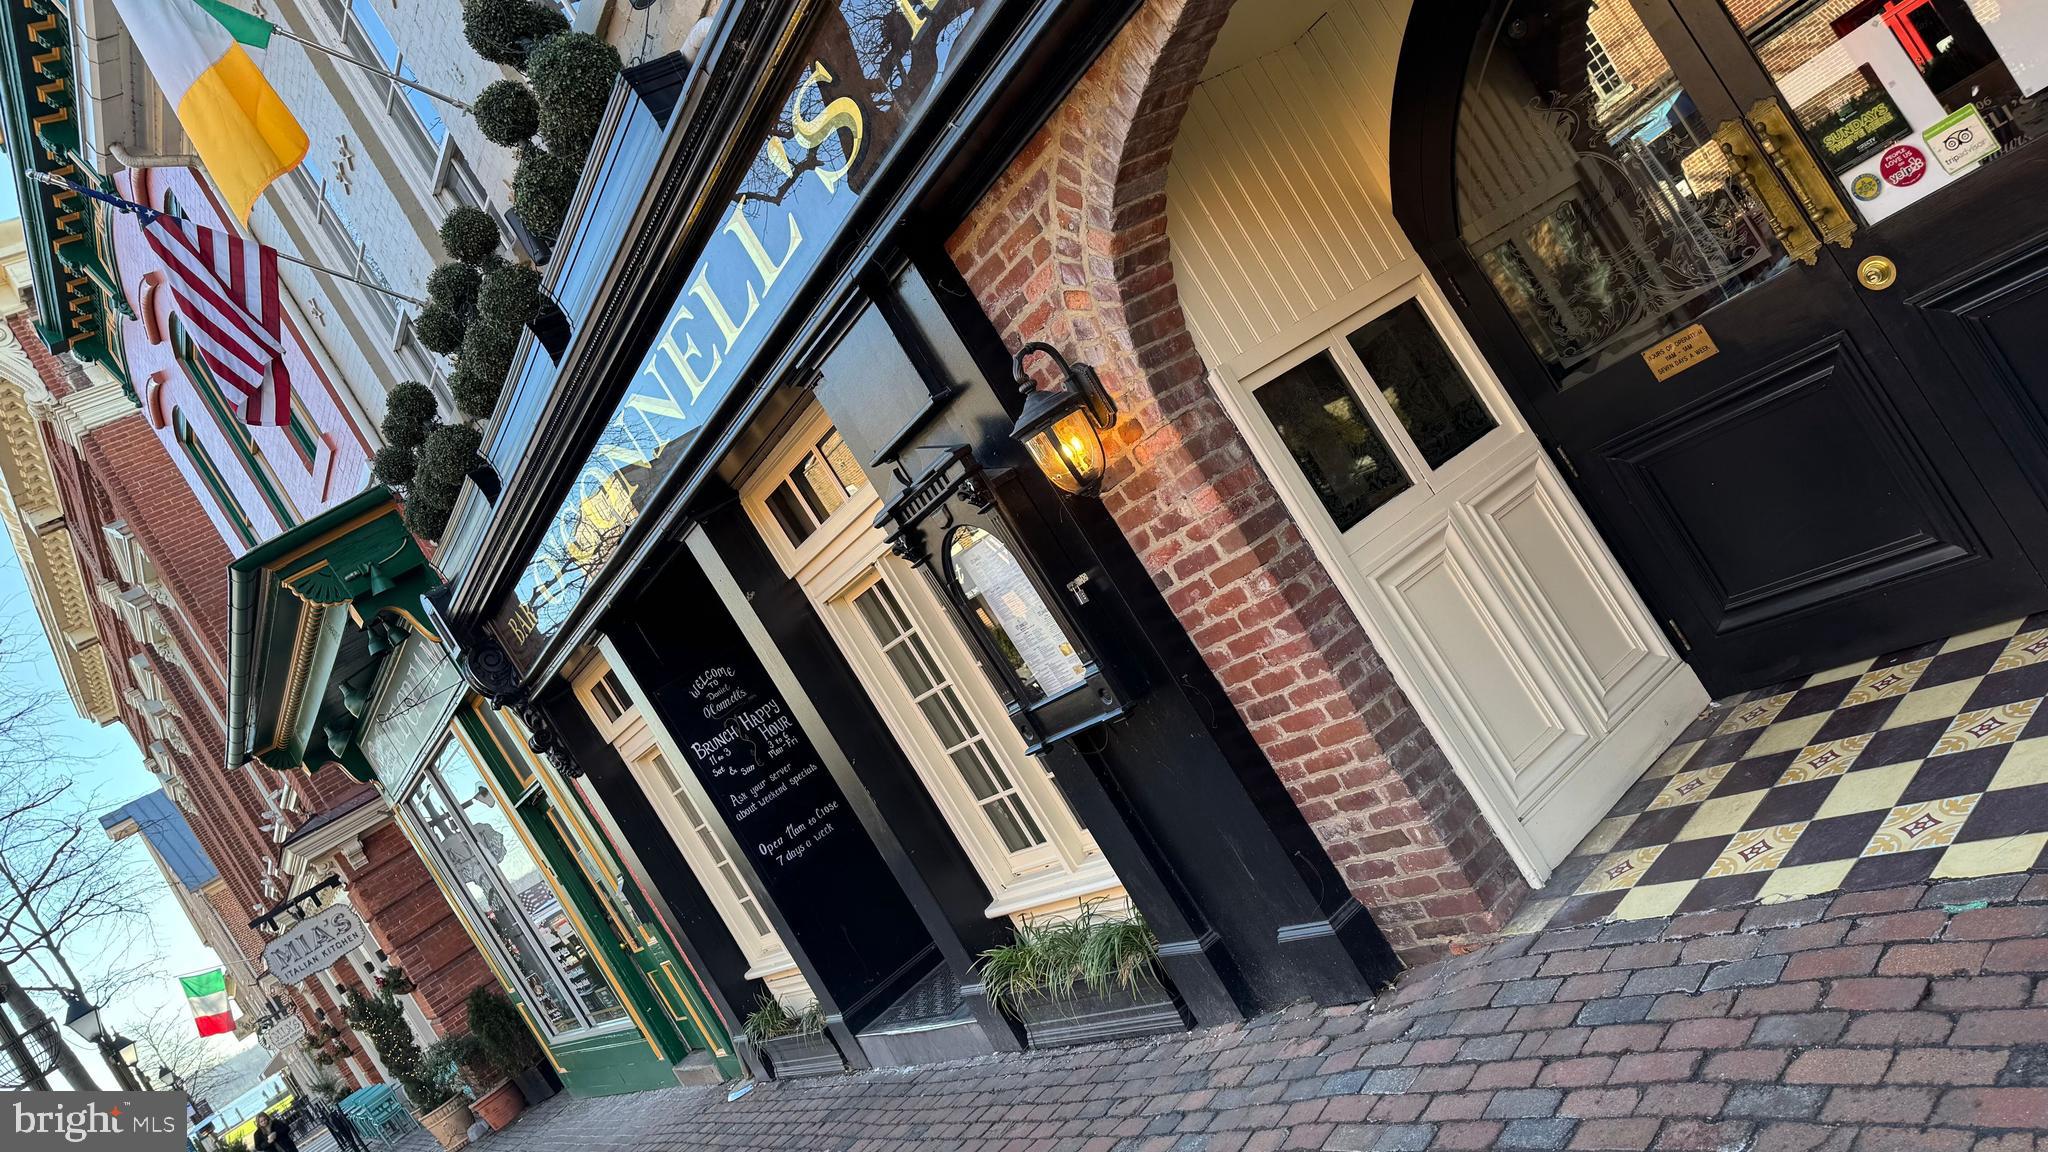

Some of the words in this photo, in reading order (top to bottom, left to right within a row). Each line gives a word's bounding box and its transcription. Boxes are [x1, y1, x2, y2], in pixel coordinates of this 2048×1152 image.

[1823, 102, 1889, 147] SUNDAYS
[1829, 128, 1866, 154] THRIVE
[1864, 112, 1894, 134] HERE
[1885, 147, 1906, 161] PEOPLE
[1885, 156, 1903, 168] LOVE
[1902, 150, 1912, 159] US
[1945, 140, 1986, 165] tripadvisor
[1889, 165, 1913, 184] yelp
[532, 60, 863, 606] O'CONNELL'S
[1665, 344, 1673, 352] OF
[1658, 363, 1674, 375] SEVEN
[1675, 356, 1689, 366] DAYS
[1695, 345, 1711, 355] WEEK
[508, 603, 537, 646] BAR
[689, 666, 735, 699] WELCOME
[706, 684, 731, 701] Daniel
[707, 679, 719, 688] TO
[703, 689, 747, 719] O'Connell's
[691, 725, 739, 760] BRUNCH
[758, 715, 793, 741] HOUR
[767, 740, 775, 749] 3
[775, 736, 783, 745] to
[782, 731, 789, 740] 6
[723, 748, 732, 759] 3
[768, 736, 799, 759] Mon-Fri
[712, 766, 726, 777] Sat
[729, 766, 738, 775] &
[740, 764, 756, 776] Sun
[729, 792, 748, 807] Ask
[750, 777, 766, 797] your
[769, 762, 792, 782] server
[735, 802, 758, 821] about
[758, 782, 788, 807] weekend
[789, 763, 818, 787] specials
[758, 838, 784, 856] Open
[808, 816, 817, 827] to
[815, 800, 839, 819] Close
[776, 855, 784, 866] 7
[785, 843, 806, 863] days
[805, 839, 812, 848] a
[813, 822, 835, 840] week
[271, 912, 352, 972] MIA'S
[284, 955, 320, 979] ITALIAN
[322, 931, 359, 957] KITCHEN
